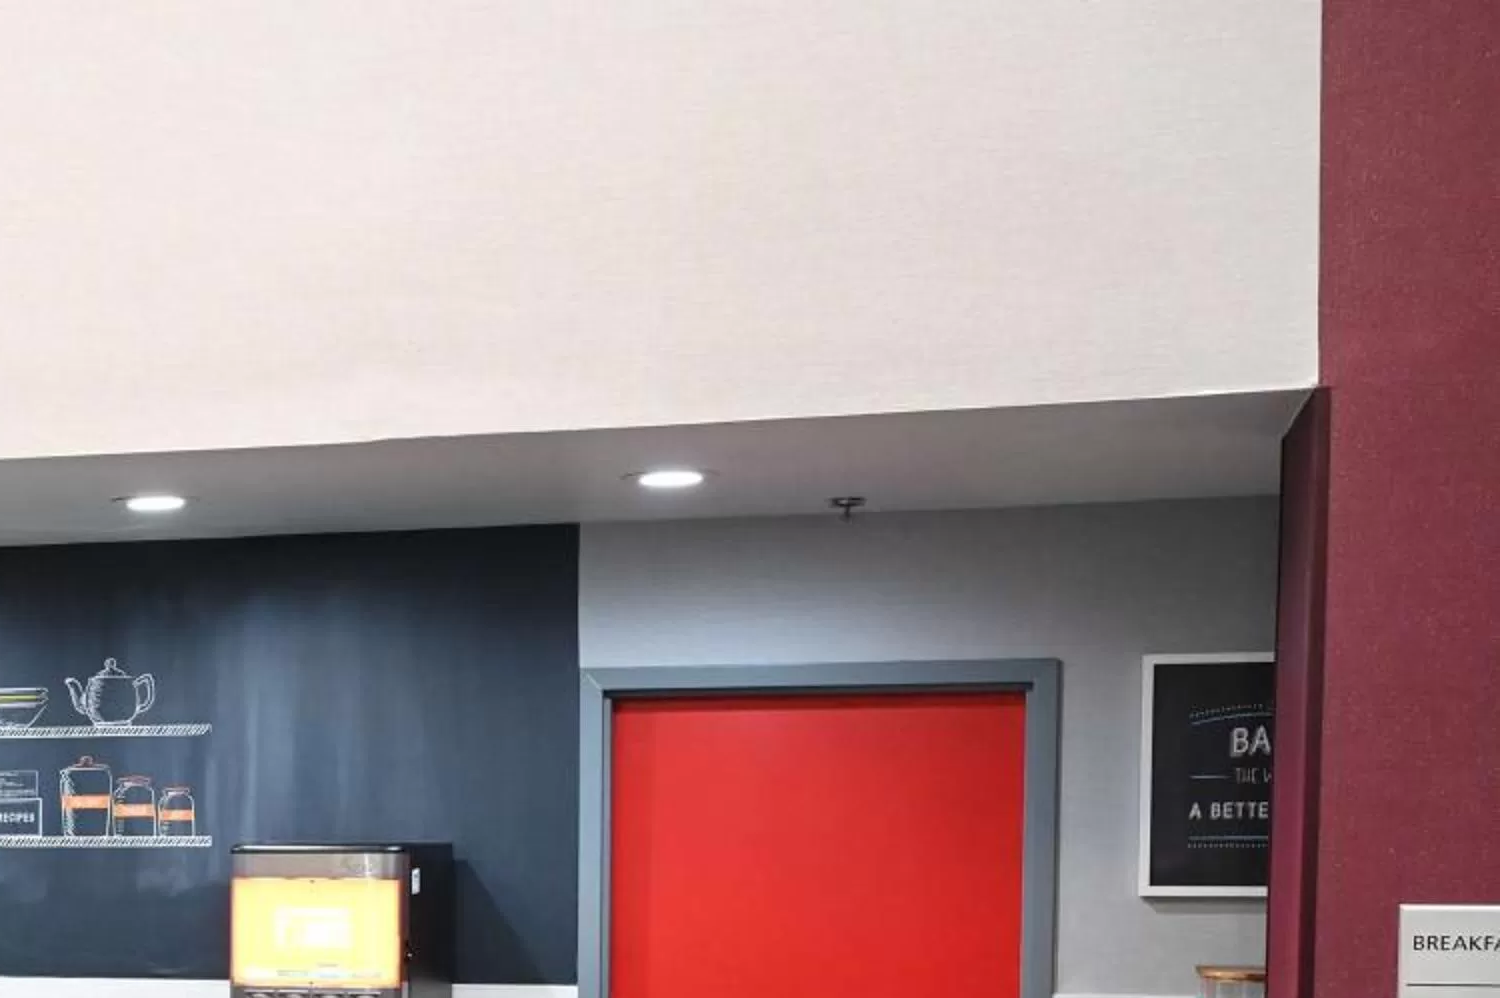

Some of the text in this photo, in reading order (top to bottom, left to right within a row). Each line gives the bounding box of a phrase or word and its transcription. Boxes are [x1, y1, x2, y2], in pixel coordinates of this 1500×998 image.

[1230, 725, 1271, 758] BA
[1188, 801, 1269, 820] A BETTE
